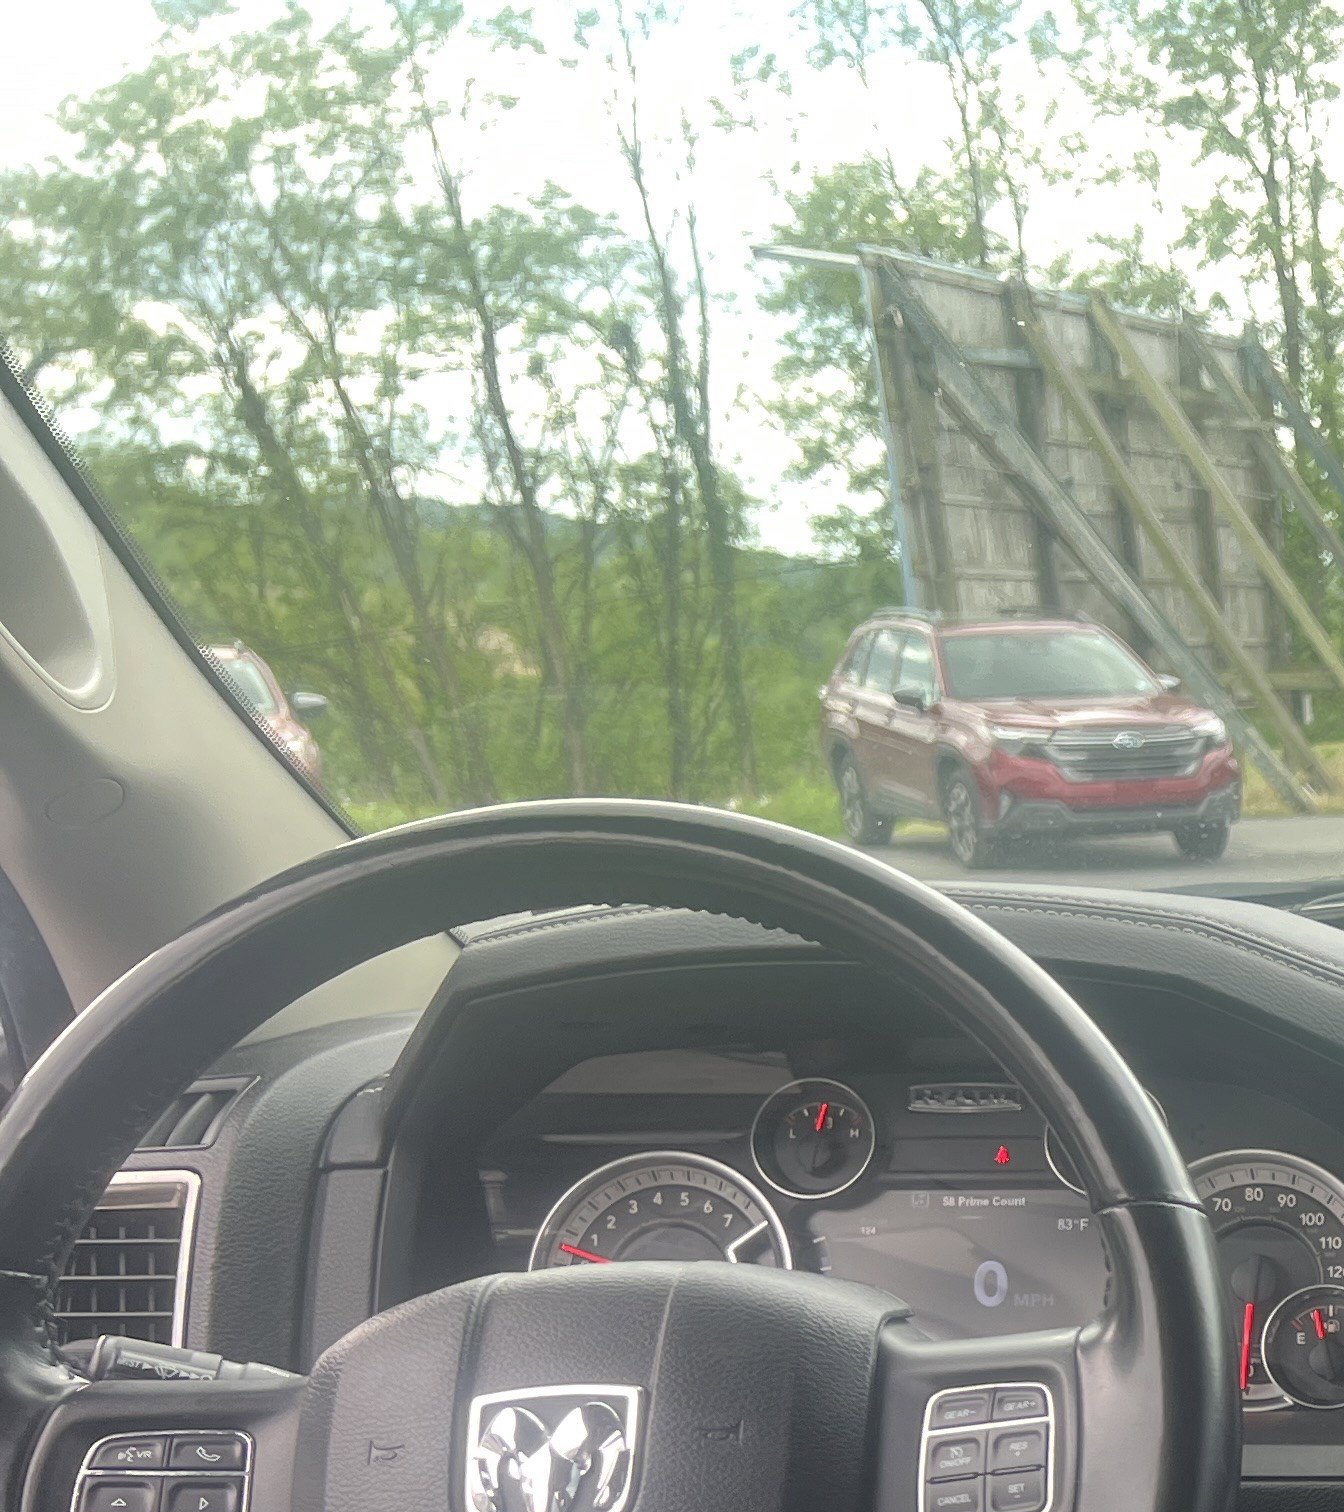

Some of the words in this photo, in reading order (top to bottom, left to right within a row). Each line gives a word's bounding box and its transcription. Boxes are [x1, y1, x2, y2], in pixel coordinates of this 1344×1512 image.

[849, 1128, 859, 1138] H
[653, 1192, 663, 1205] 4
[680, 1192, 690, 1206] 5
[1245, 1187, 1264, 1201] 80
[1277, 1194, 1297, 1208] 90
[628, 1200, 638, 1214] 3
[703, 1200, 713, 1214] 6
[958, 1196, 990, 1207] Prime
[1212, 1197, 1232, 1212] 70
[606, 1215, 616, 1230] 2
[722, 1214, 733, 1228] 7
[1300, 1213, 1325, 1226] 100
[591, 1234, 598, 1247] 1
[1319, 1236, 1343, 1250] 110
[973, 1260, 1009, 1308] 0
[1296, 1332, 1306, 1345] E
